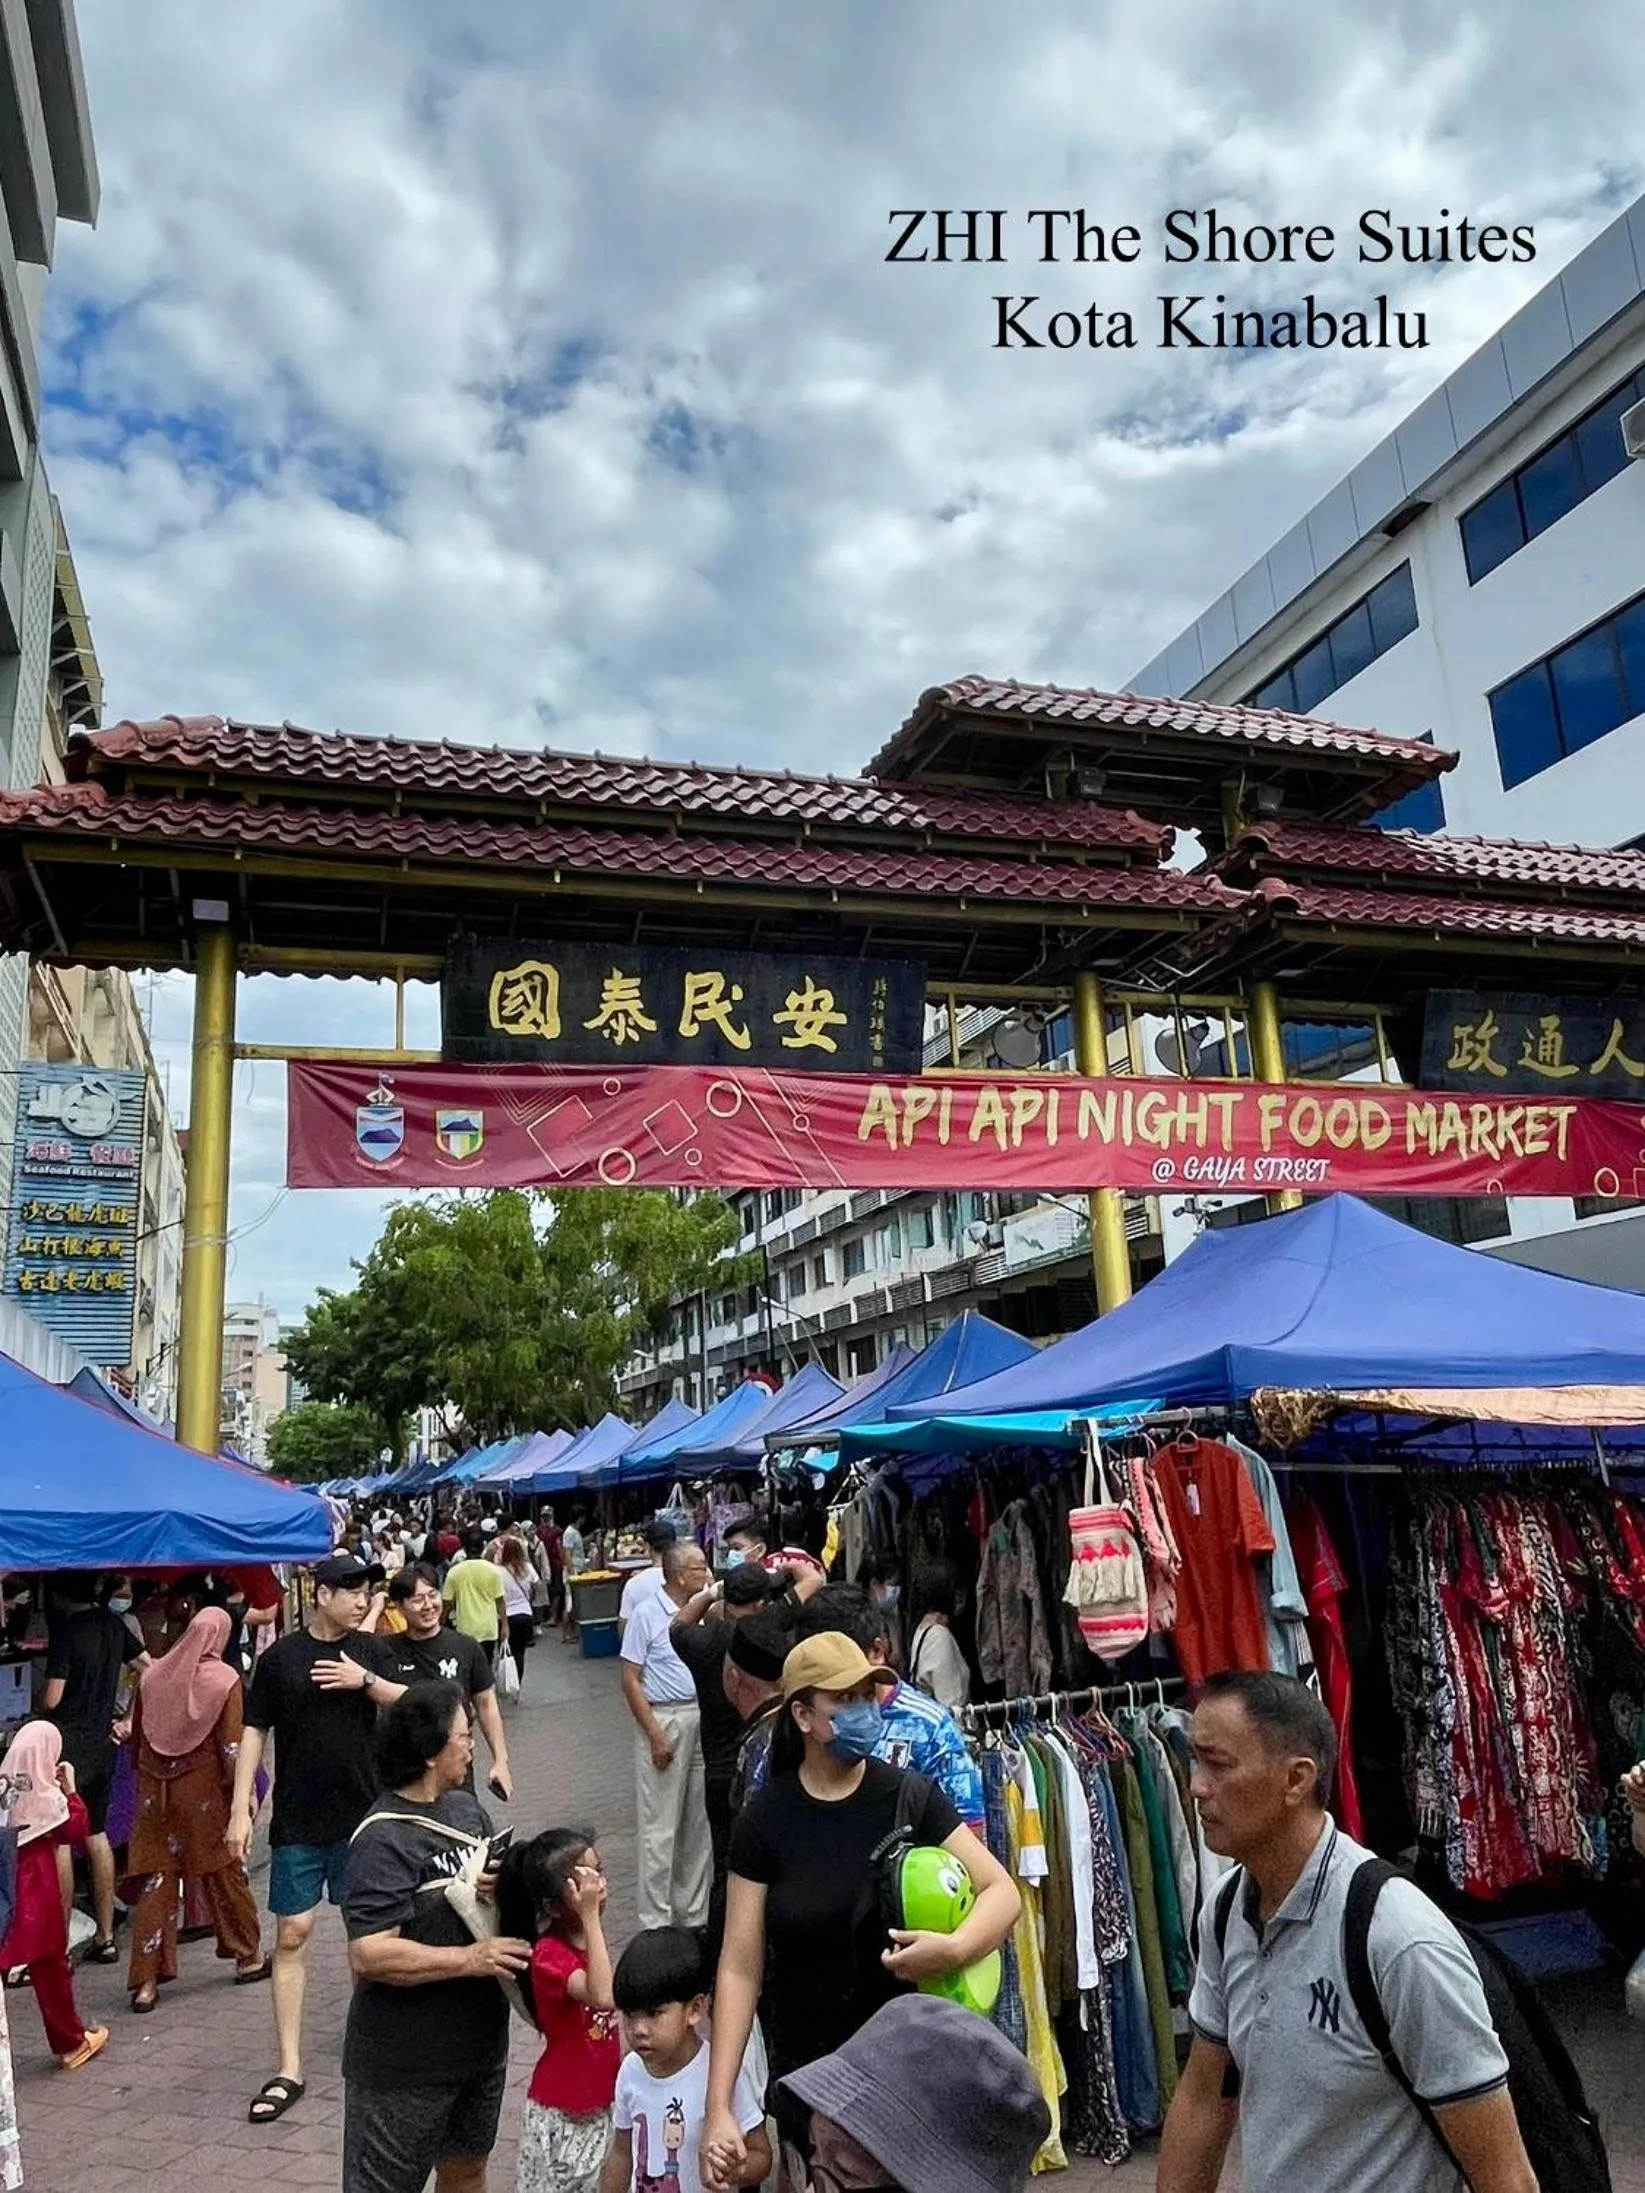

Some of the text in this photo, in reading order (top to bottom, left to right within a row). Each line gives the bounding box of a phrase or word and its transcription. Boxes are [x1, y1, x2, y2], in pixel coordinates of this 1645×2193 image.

[489, 959, 848, 1053] 國泰民安
[1447, 1008, 1645, 1077] 政通人
[857, 1083, 1578, 1162] API API NIGHT FOOD MARKET
[24, 1164, 134, 1179] Seafood Restaurant
[1151, 1155, 1331, 1188] @ GAYA STREET
